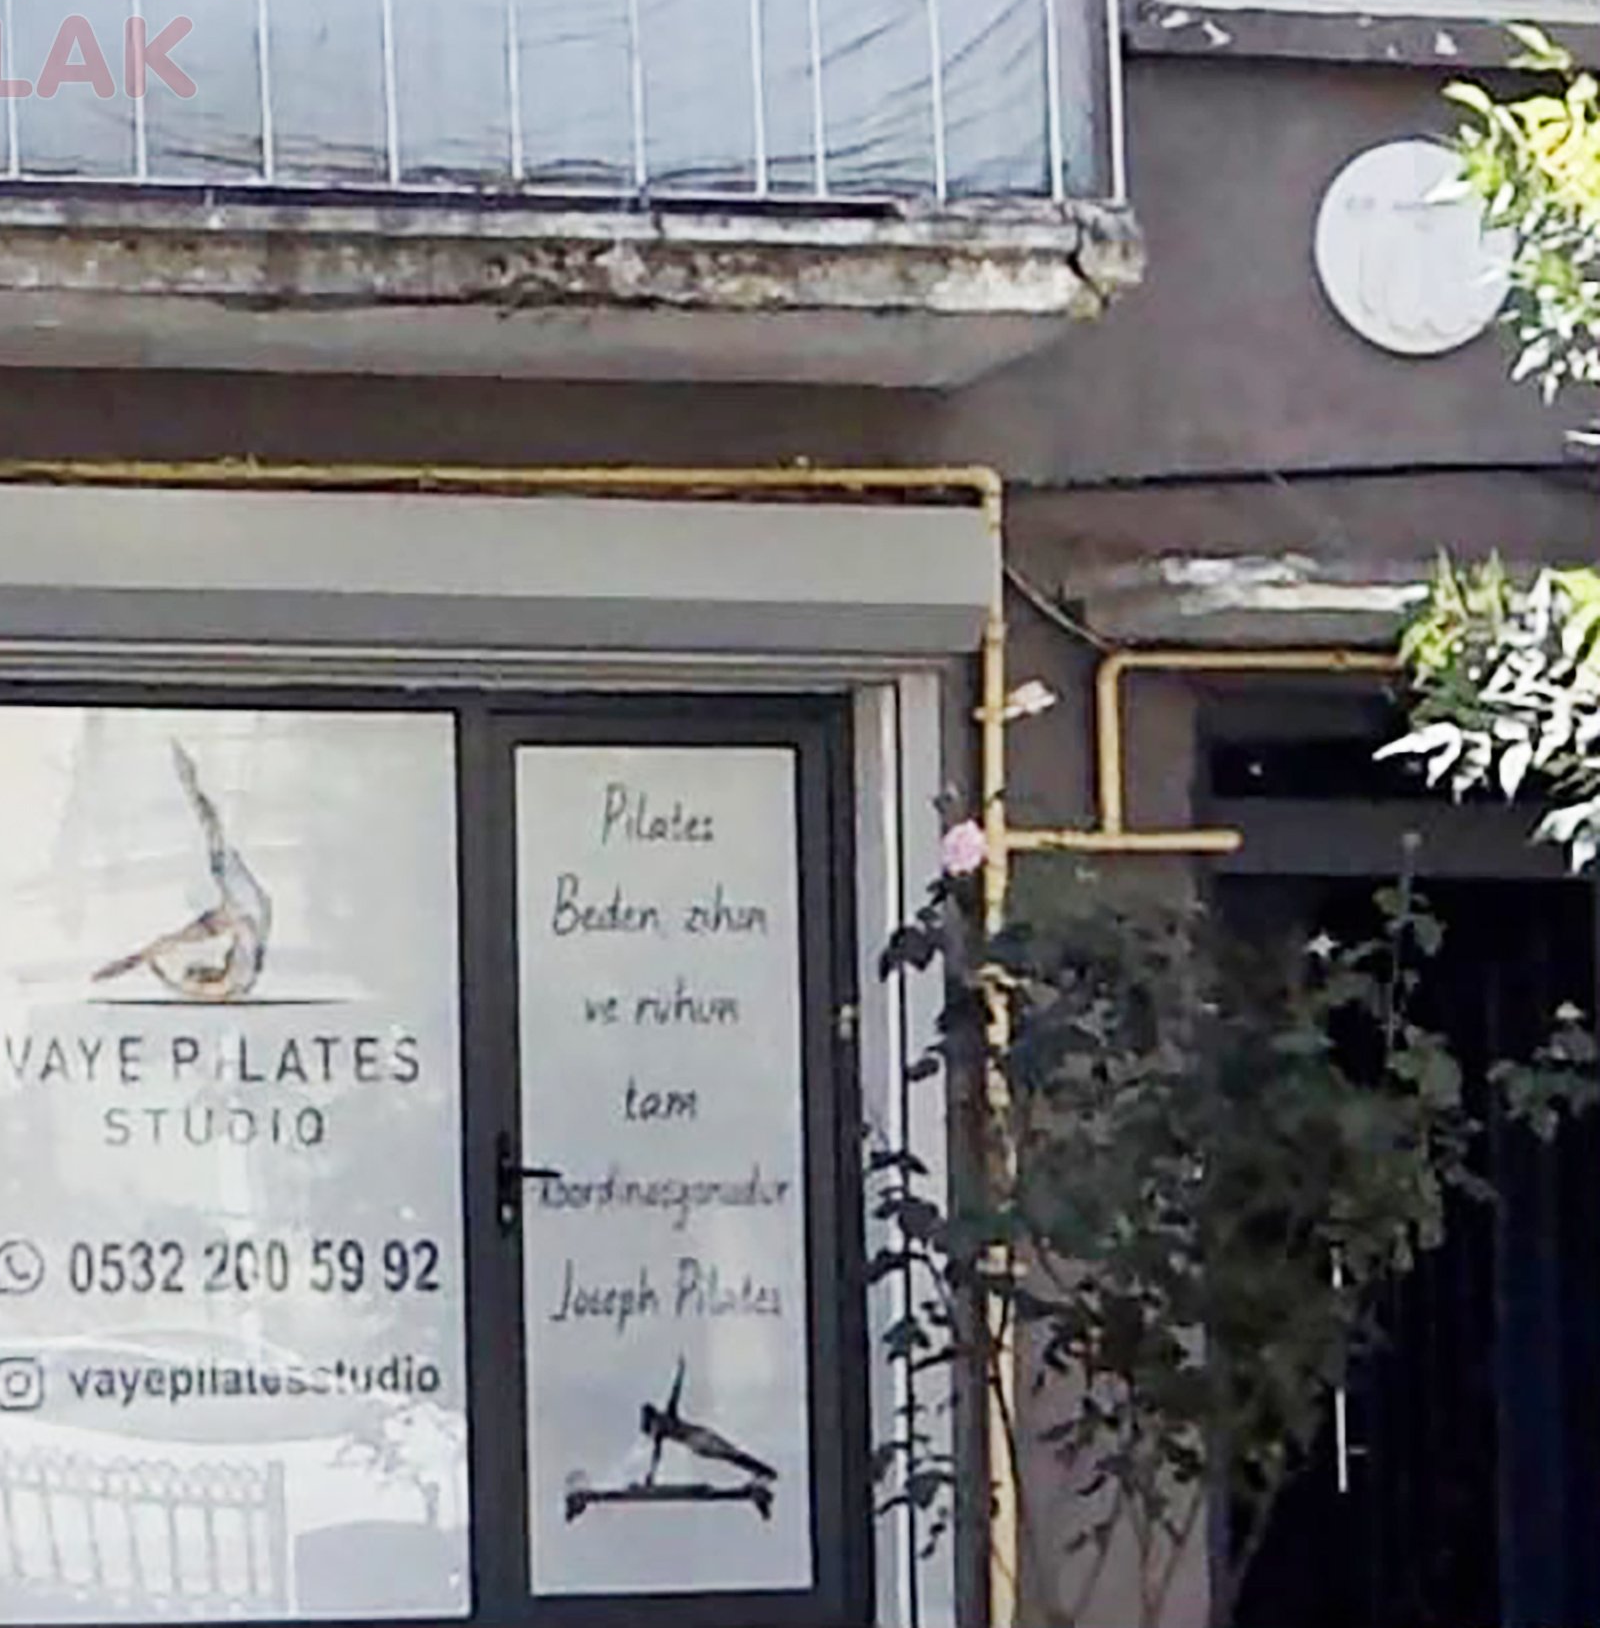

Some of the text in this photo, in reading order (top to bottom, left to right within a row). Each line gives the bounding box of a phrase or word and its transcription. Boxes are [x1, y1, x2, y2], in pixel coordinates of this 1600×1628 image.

[4, 1036, 144, 1085] VAYE
[68, 1238, 441, 1295] 0532 200 59 92
